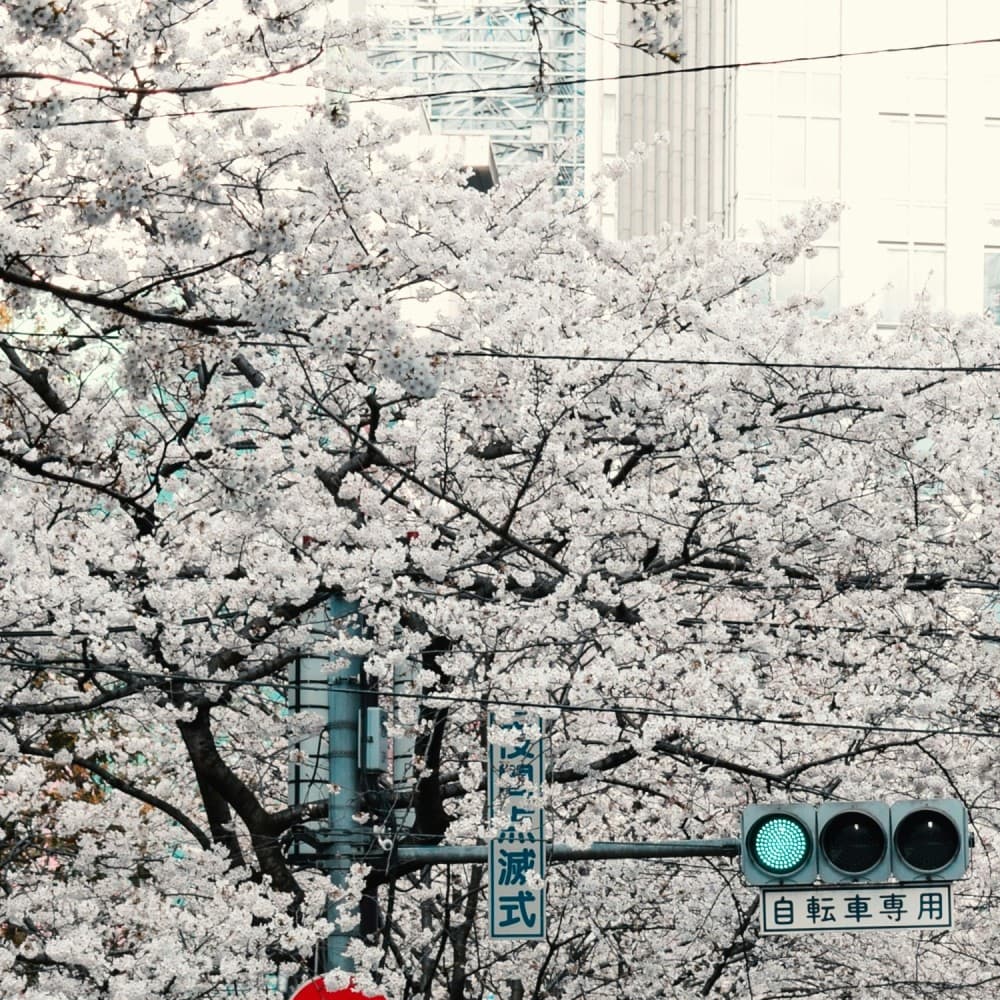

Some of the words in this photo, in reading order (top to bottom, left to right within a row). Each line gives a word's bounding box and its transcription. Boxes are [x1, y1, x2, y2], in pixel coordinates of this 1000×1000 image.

[773, 892, 943, 925] 自転車専用
